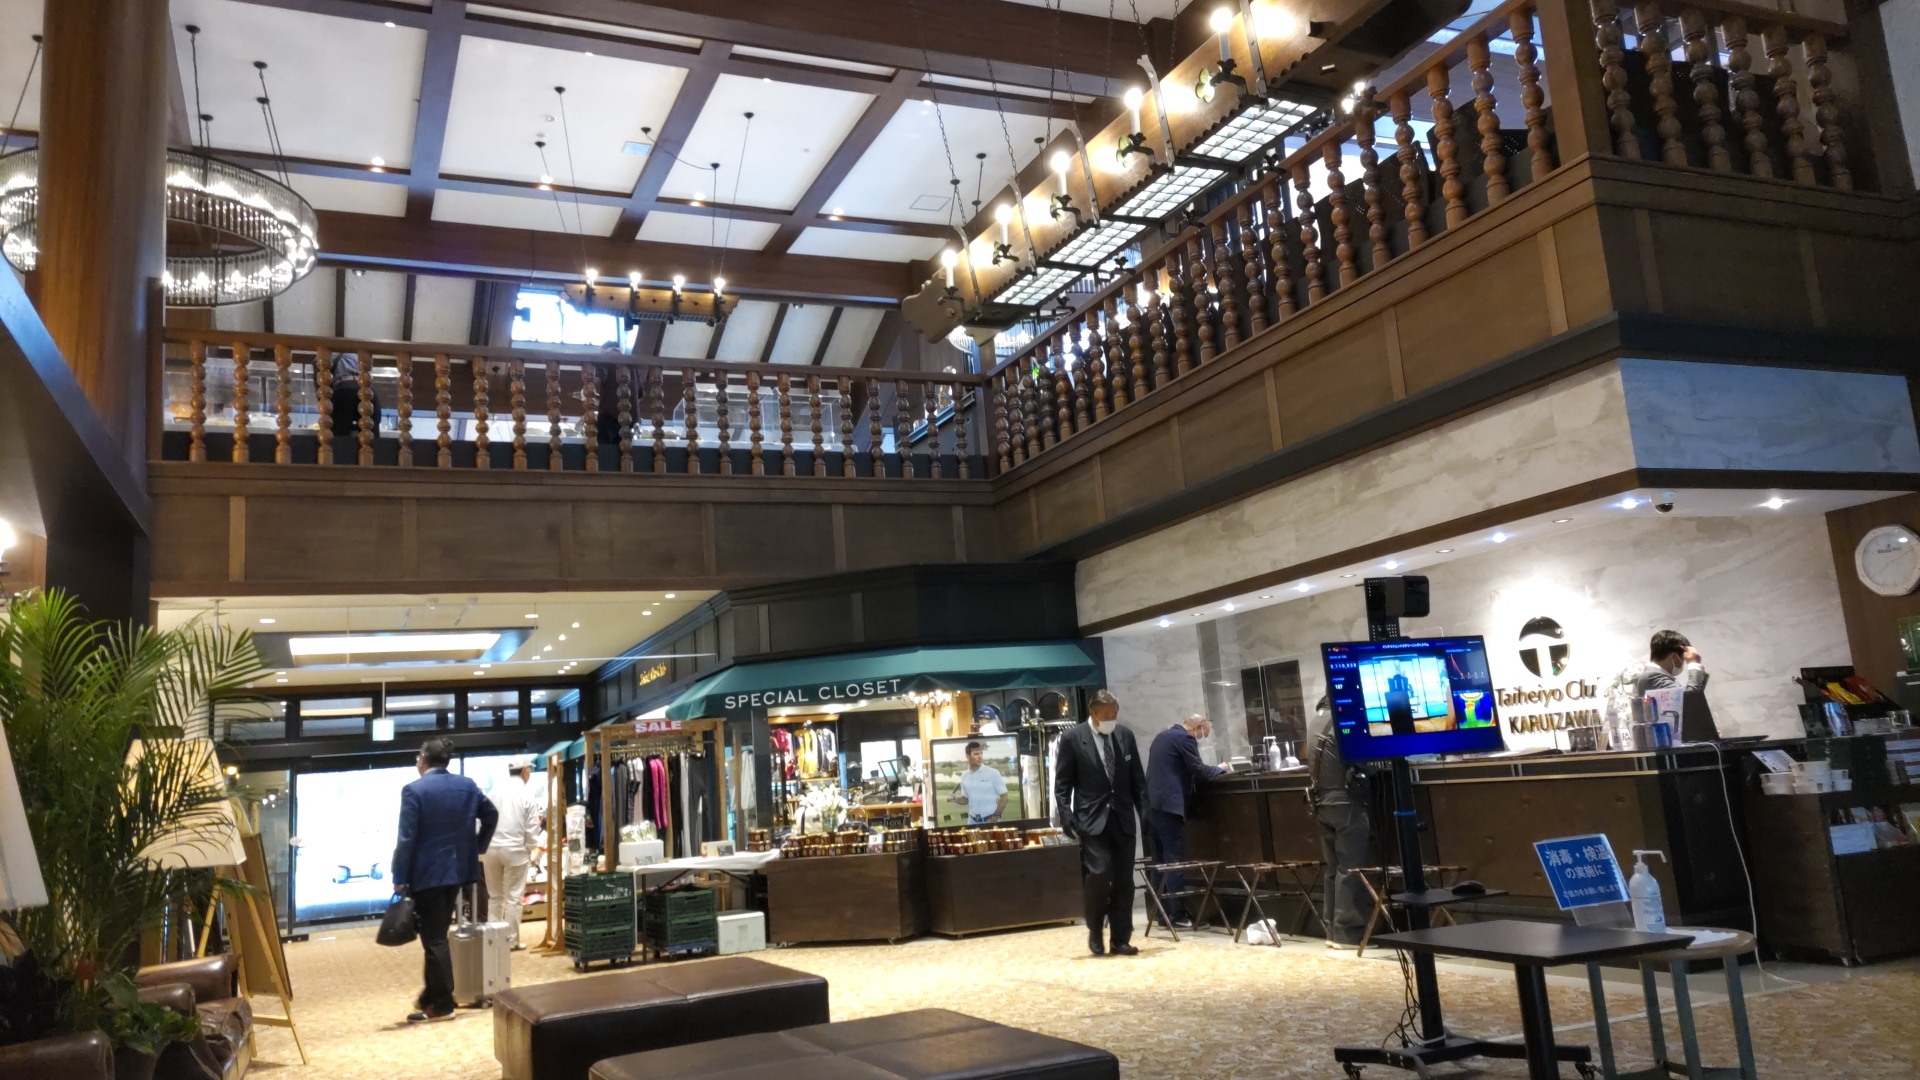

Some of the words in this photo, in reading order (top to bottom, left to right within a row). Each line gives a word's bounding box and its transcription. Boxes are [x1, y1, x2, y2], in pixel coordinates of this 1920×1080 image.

[724, 688, 809, 710] SPECIAL
[818, 678, 901, 701] CLOSET
[1495, 683, 1564, 708] Taiheiyo
[1566, 677, 1603, 700] Clu
[634, 719, 682, 733] SALE
[1508, 708, 1603, 735] KARUIZAWA
[1545, 844, 1611, 867] 消毒・検温
[1565, 864, 1606, 880] の実施に
